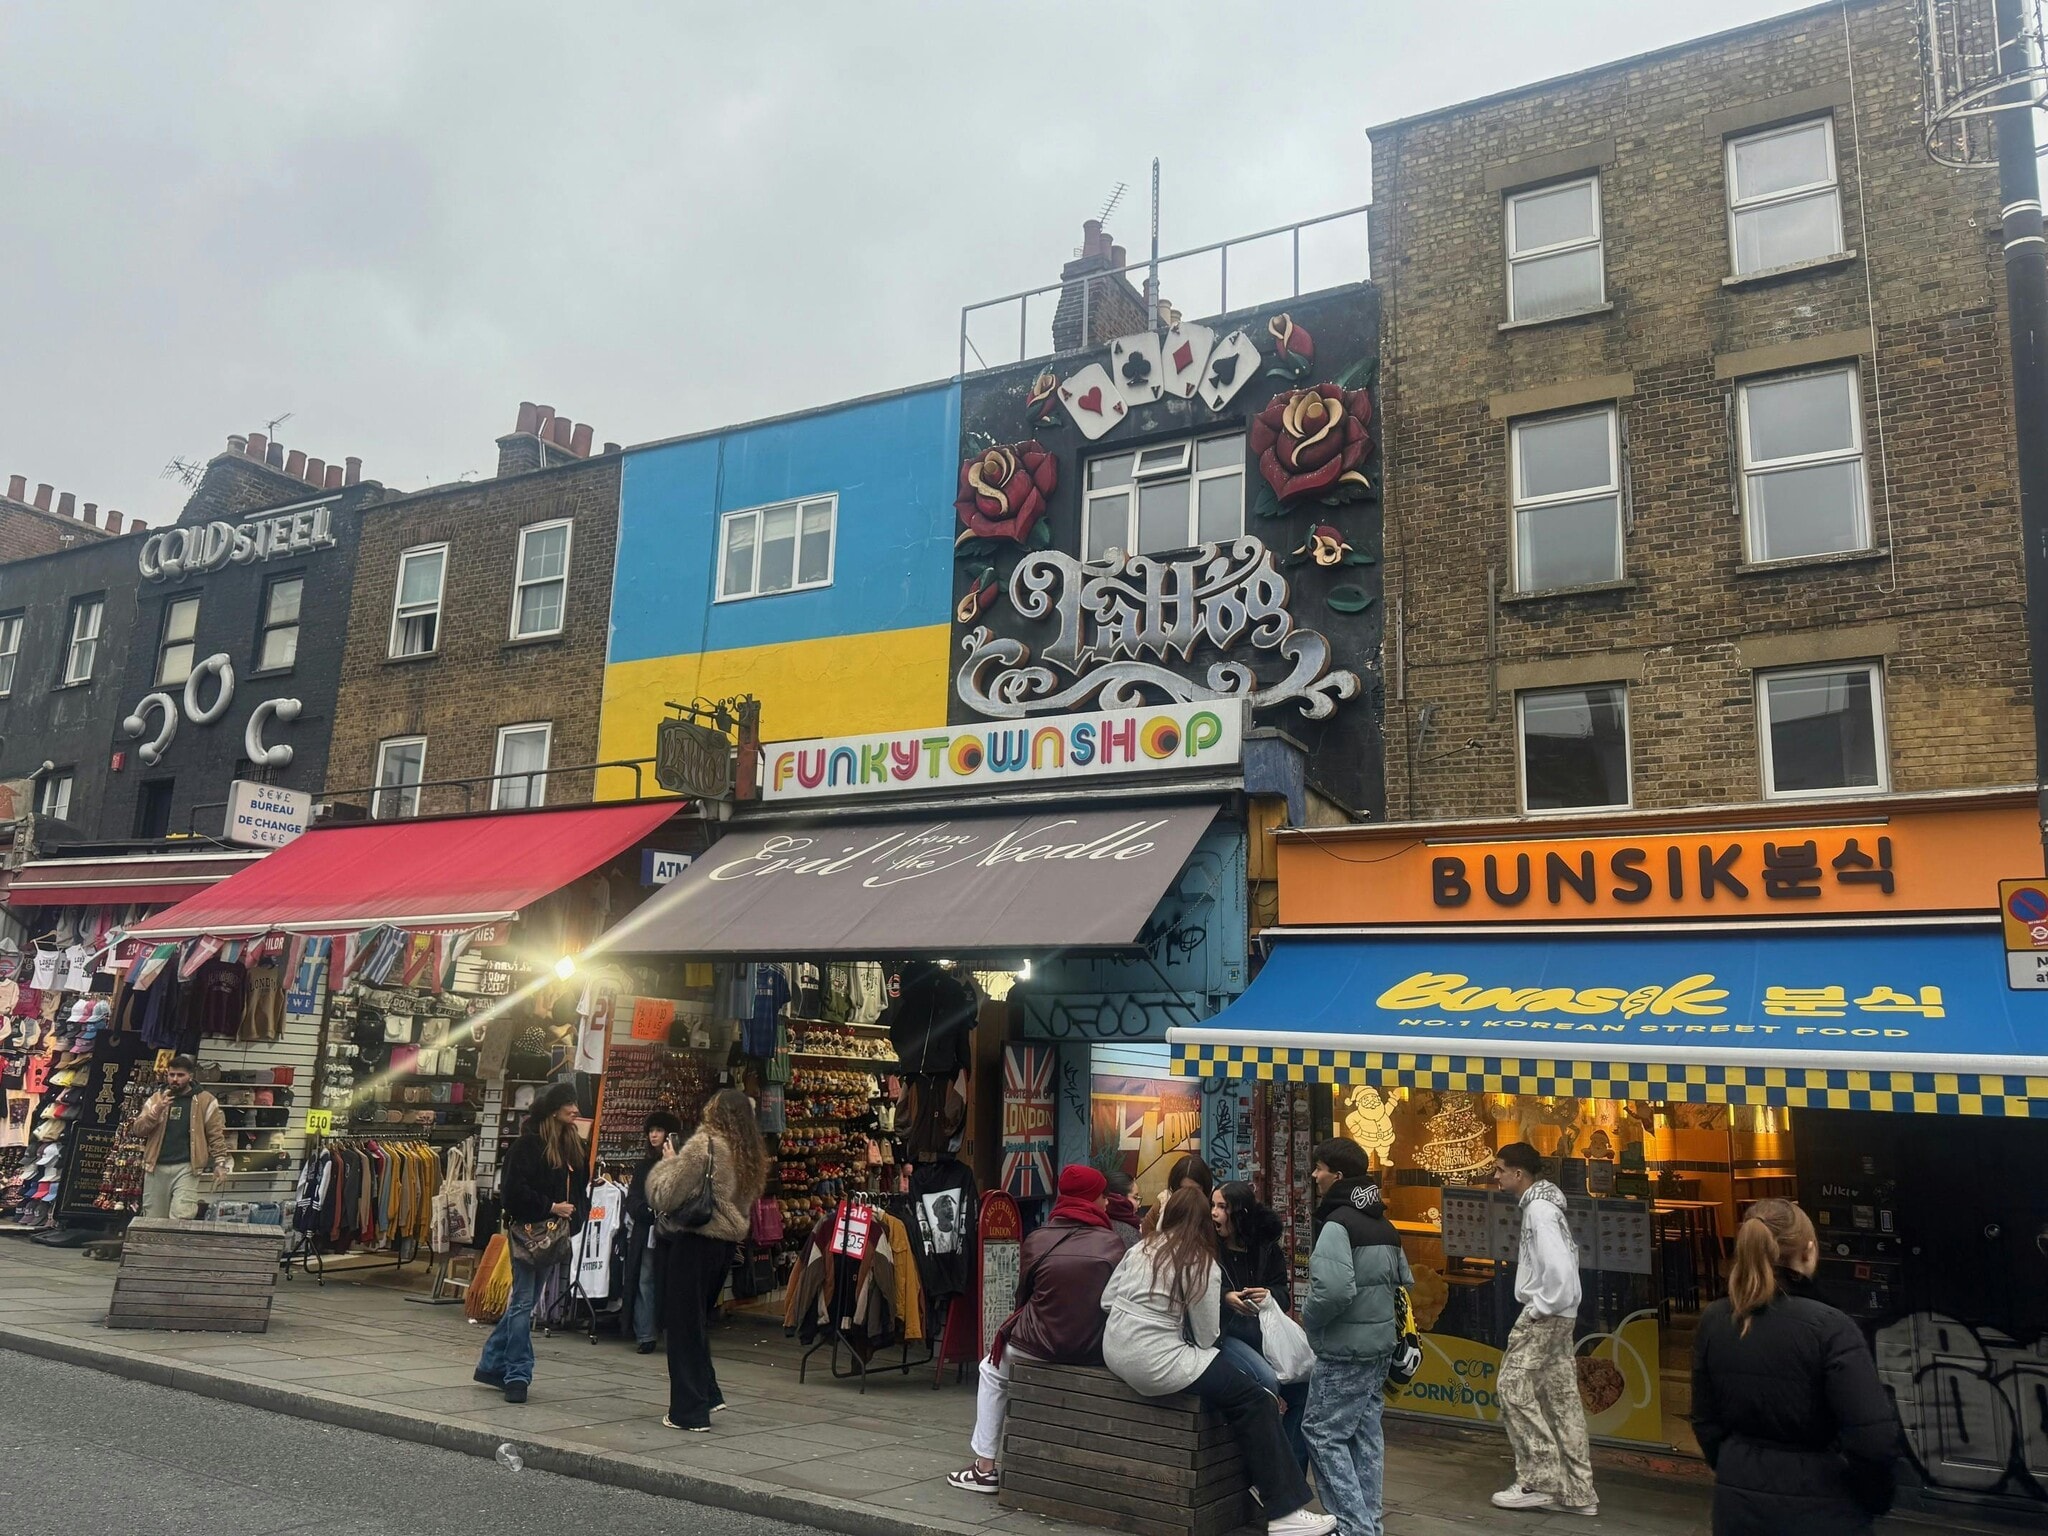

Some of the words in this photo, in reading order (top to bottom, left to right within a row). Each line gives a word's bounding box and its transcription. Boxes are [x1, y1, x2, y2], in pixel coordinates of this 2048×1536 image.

[250, 800, 294, 815] BUREAU
[238, 815, 253, 825] DE
[255, 818, 302, 833] CHANGE
[656, 861, 688, 877] ATM
[1433, 842, 1749, 907] BUNSIK
[1761, 836, 1895, 900] 분식
[1375, 971, 1730, 1020] Bunsik
[1761, 986, 1945, 1018] 분식
[1398, 1017, 1471, 1028] NO.1
[1482, 1019, 1626, 1032] KOREAN
[1639, 1023, 1781, 1035] STREET
[1796, 1026, 1909, 1038] FOOD
[309, 1115, 328, 1129] £10
[1002, 1103, 1054, 1135] LONDON
[989, 1226, 1012, 1237] LONDON
